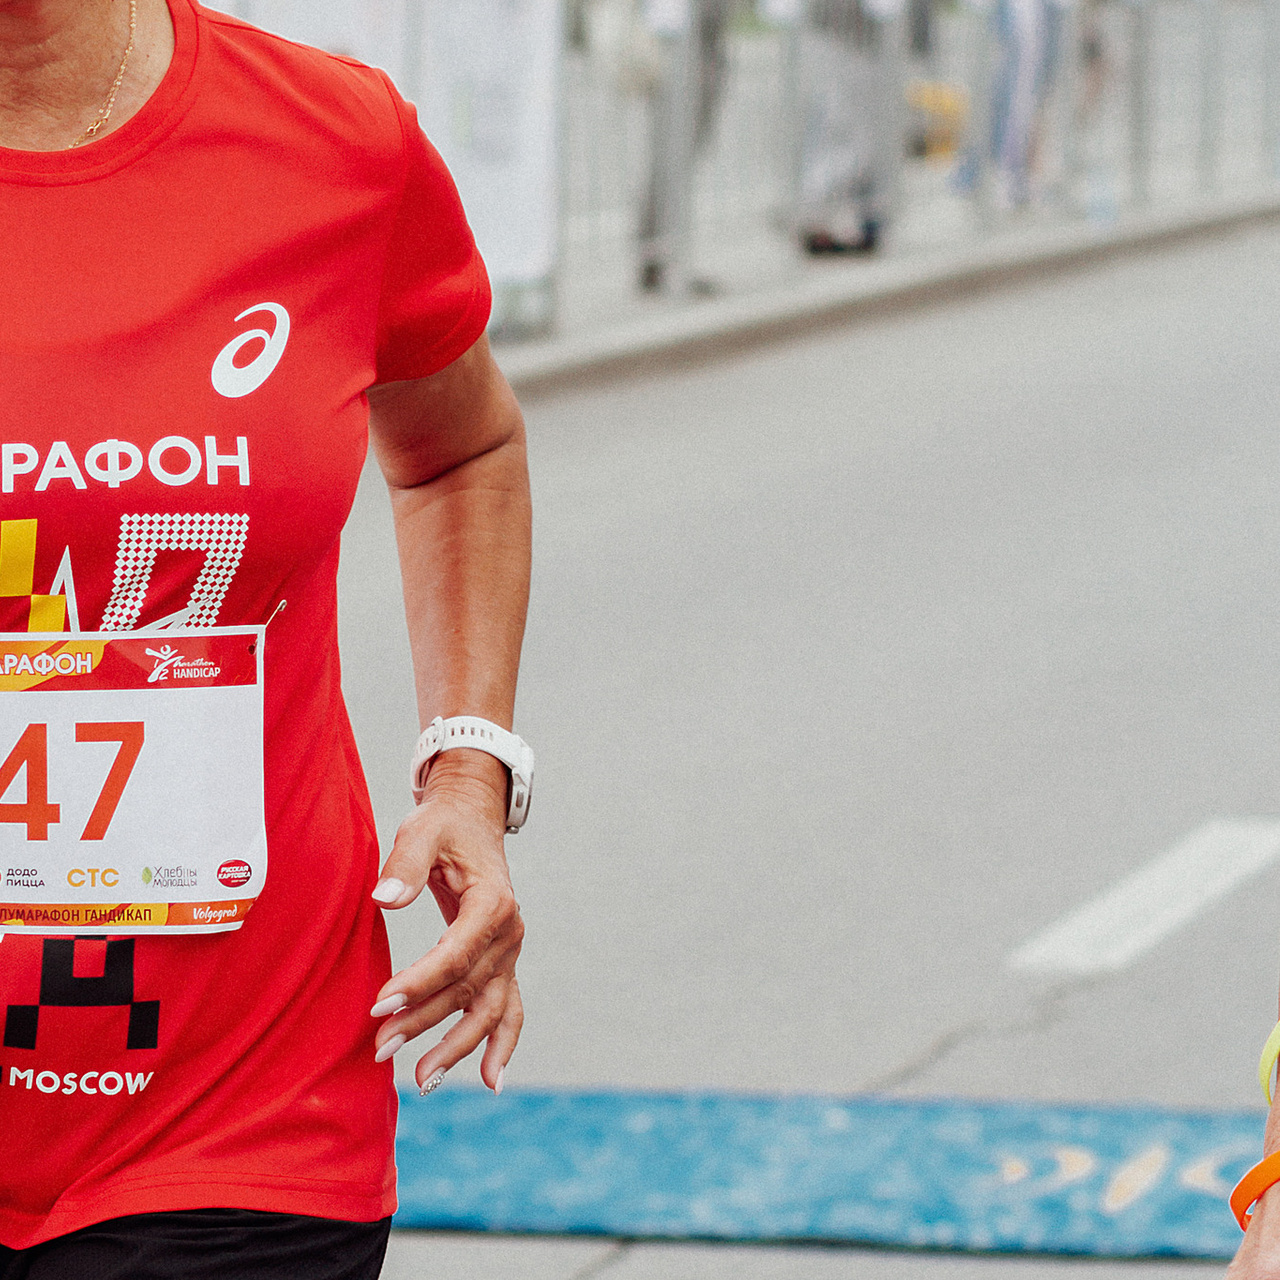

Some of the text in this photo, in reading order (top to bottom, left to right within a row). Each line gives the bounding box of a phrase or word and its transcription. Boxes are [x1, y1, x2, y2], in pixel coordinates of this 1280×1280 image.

[173, 667, 221, 679] HANDICAP
[6, 868, 38, 877] ДОДО
[66, 868, 119, 887] СТС
[154, 866, 197, 879] Хлебцы
[6, 878, 45, 887] ПИЦЦА
[85, 908, 152, 923] ГАНДИКАП
[193, 905, 238, 923] Volgograd
[9, 1066, 154, 1095] MOSCOW
